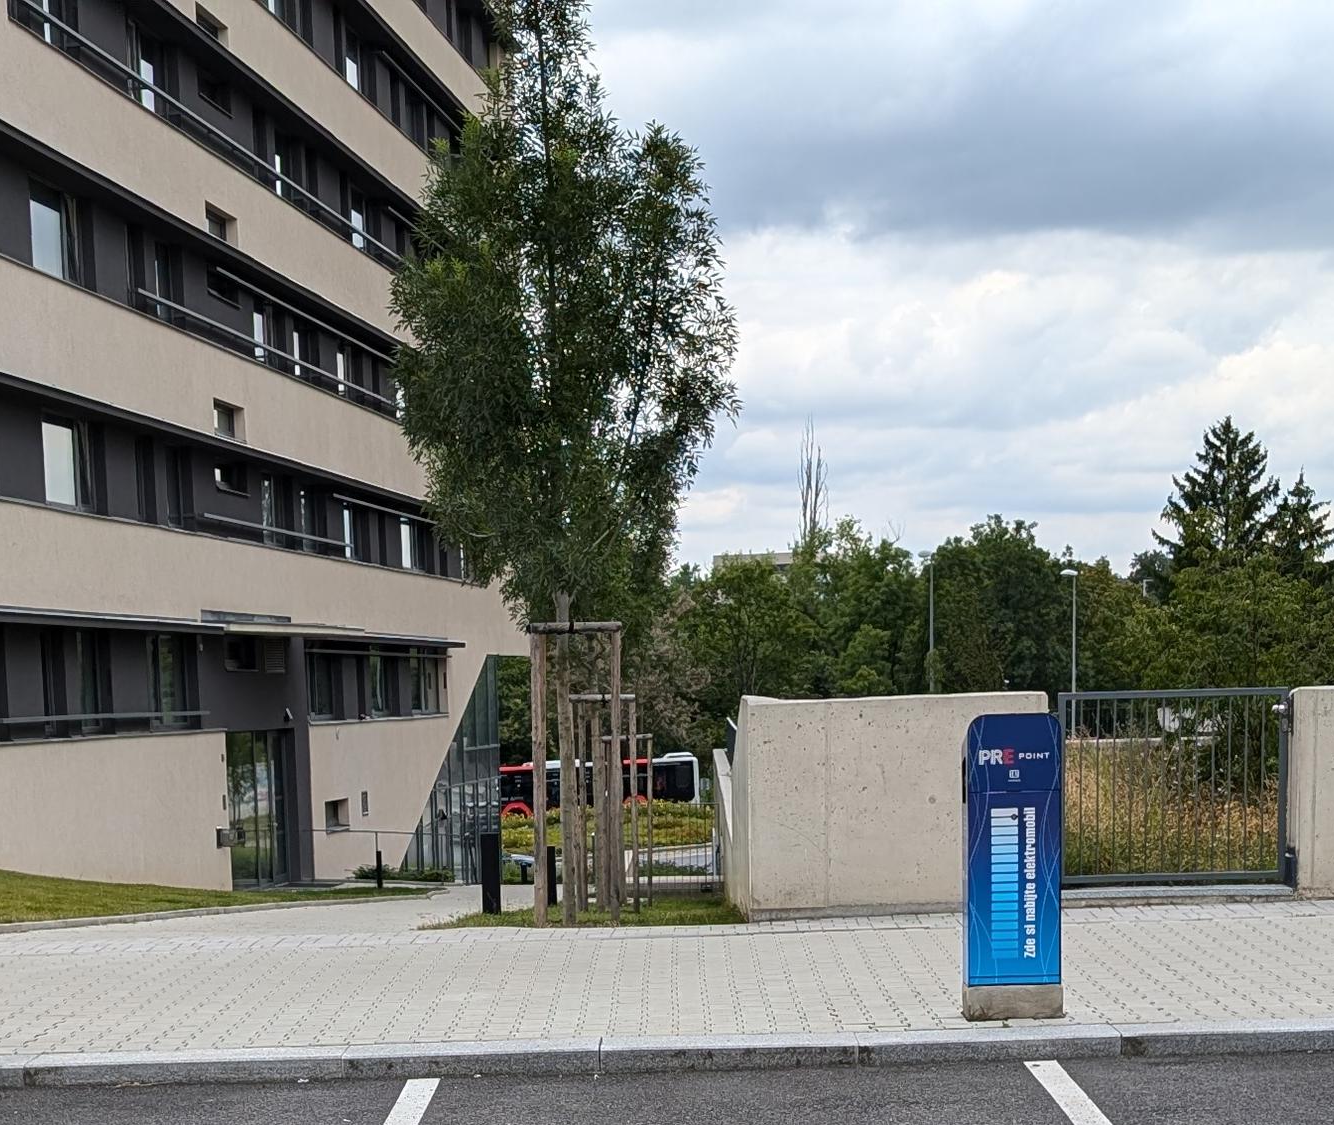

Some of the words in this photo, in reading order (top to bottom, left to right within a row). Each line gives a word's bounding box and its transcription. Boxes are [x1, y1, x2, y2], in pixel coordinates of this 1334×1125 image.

[978, 748, 1014, 766] PRE
[1018, 752, 1050, 760] POINT
[1023, 806, 1036, 880] elektromobil
[1023, 937, 1036, 959] Zde
